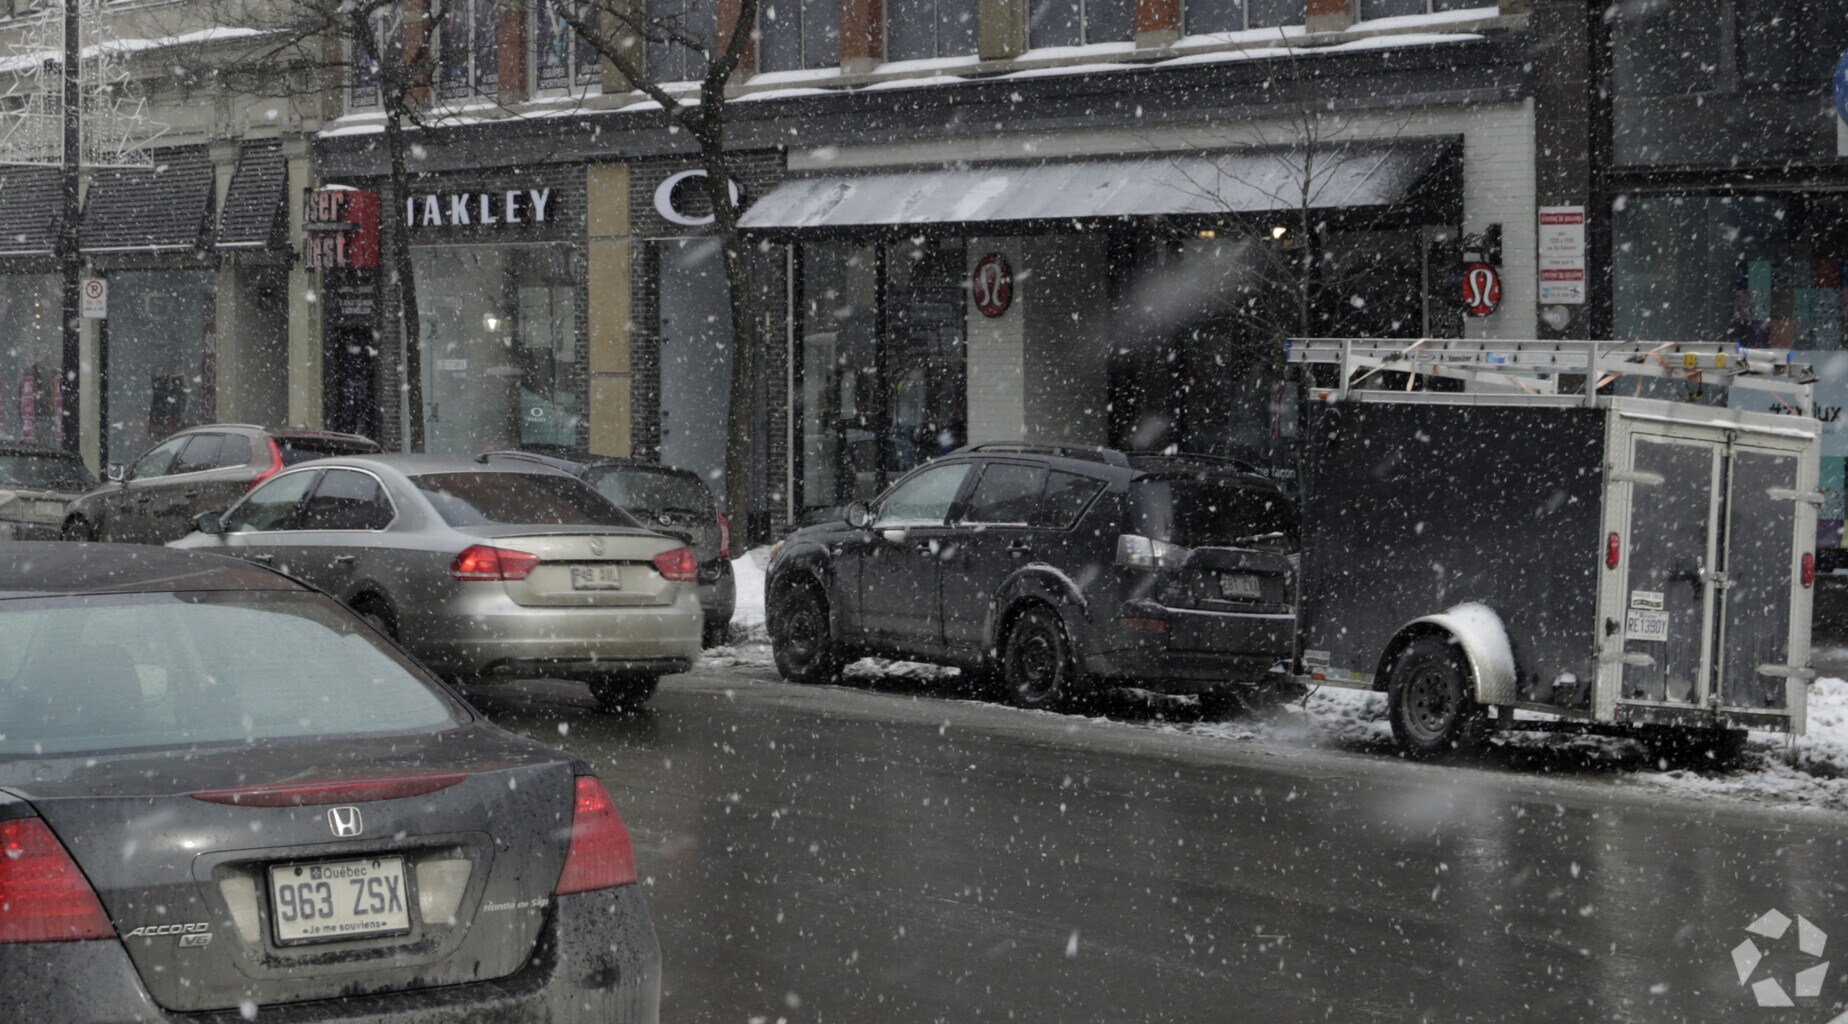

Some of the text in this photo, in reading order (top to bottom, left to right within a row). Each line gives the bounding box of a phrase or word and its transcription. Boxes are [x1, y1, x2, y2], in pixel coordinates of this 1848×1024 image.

[323, 865, 367, 879] Québec
[279, 875, 403, 922] 963 ZSX
[126, 922, 209, 938] ACCORD
[309, 921, 381, 936] Je me souviens
[179, 933, 213, 948] V6
